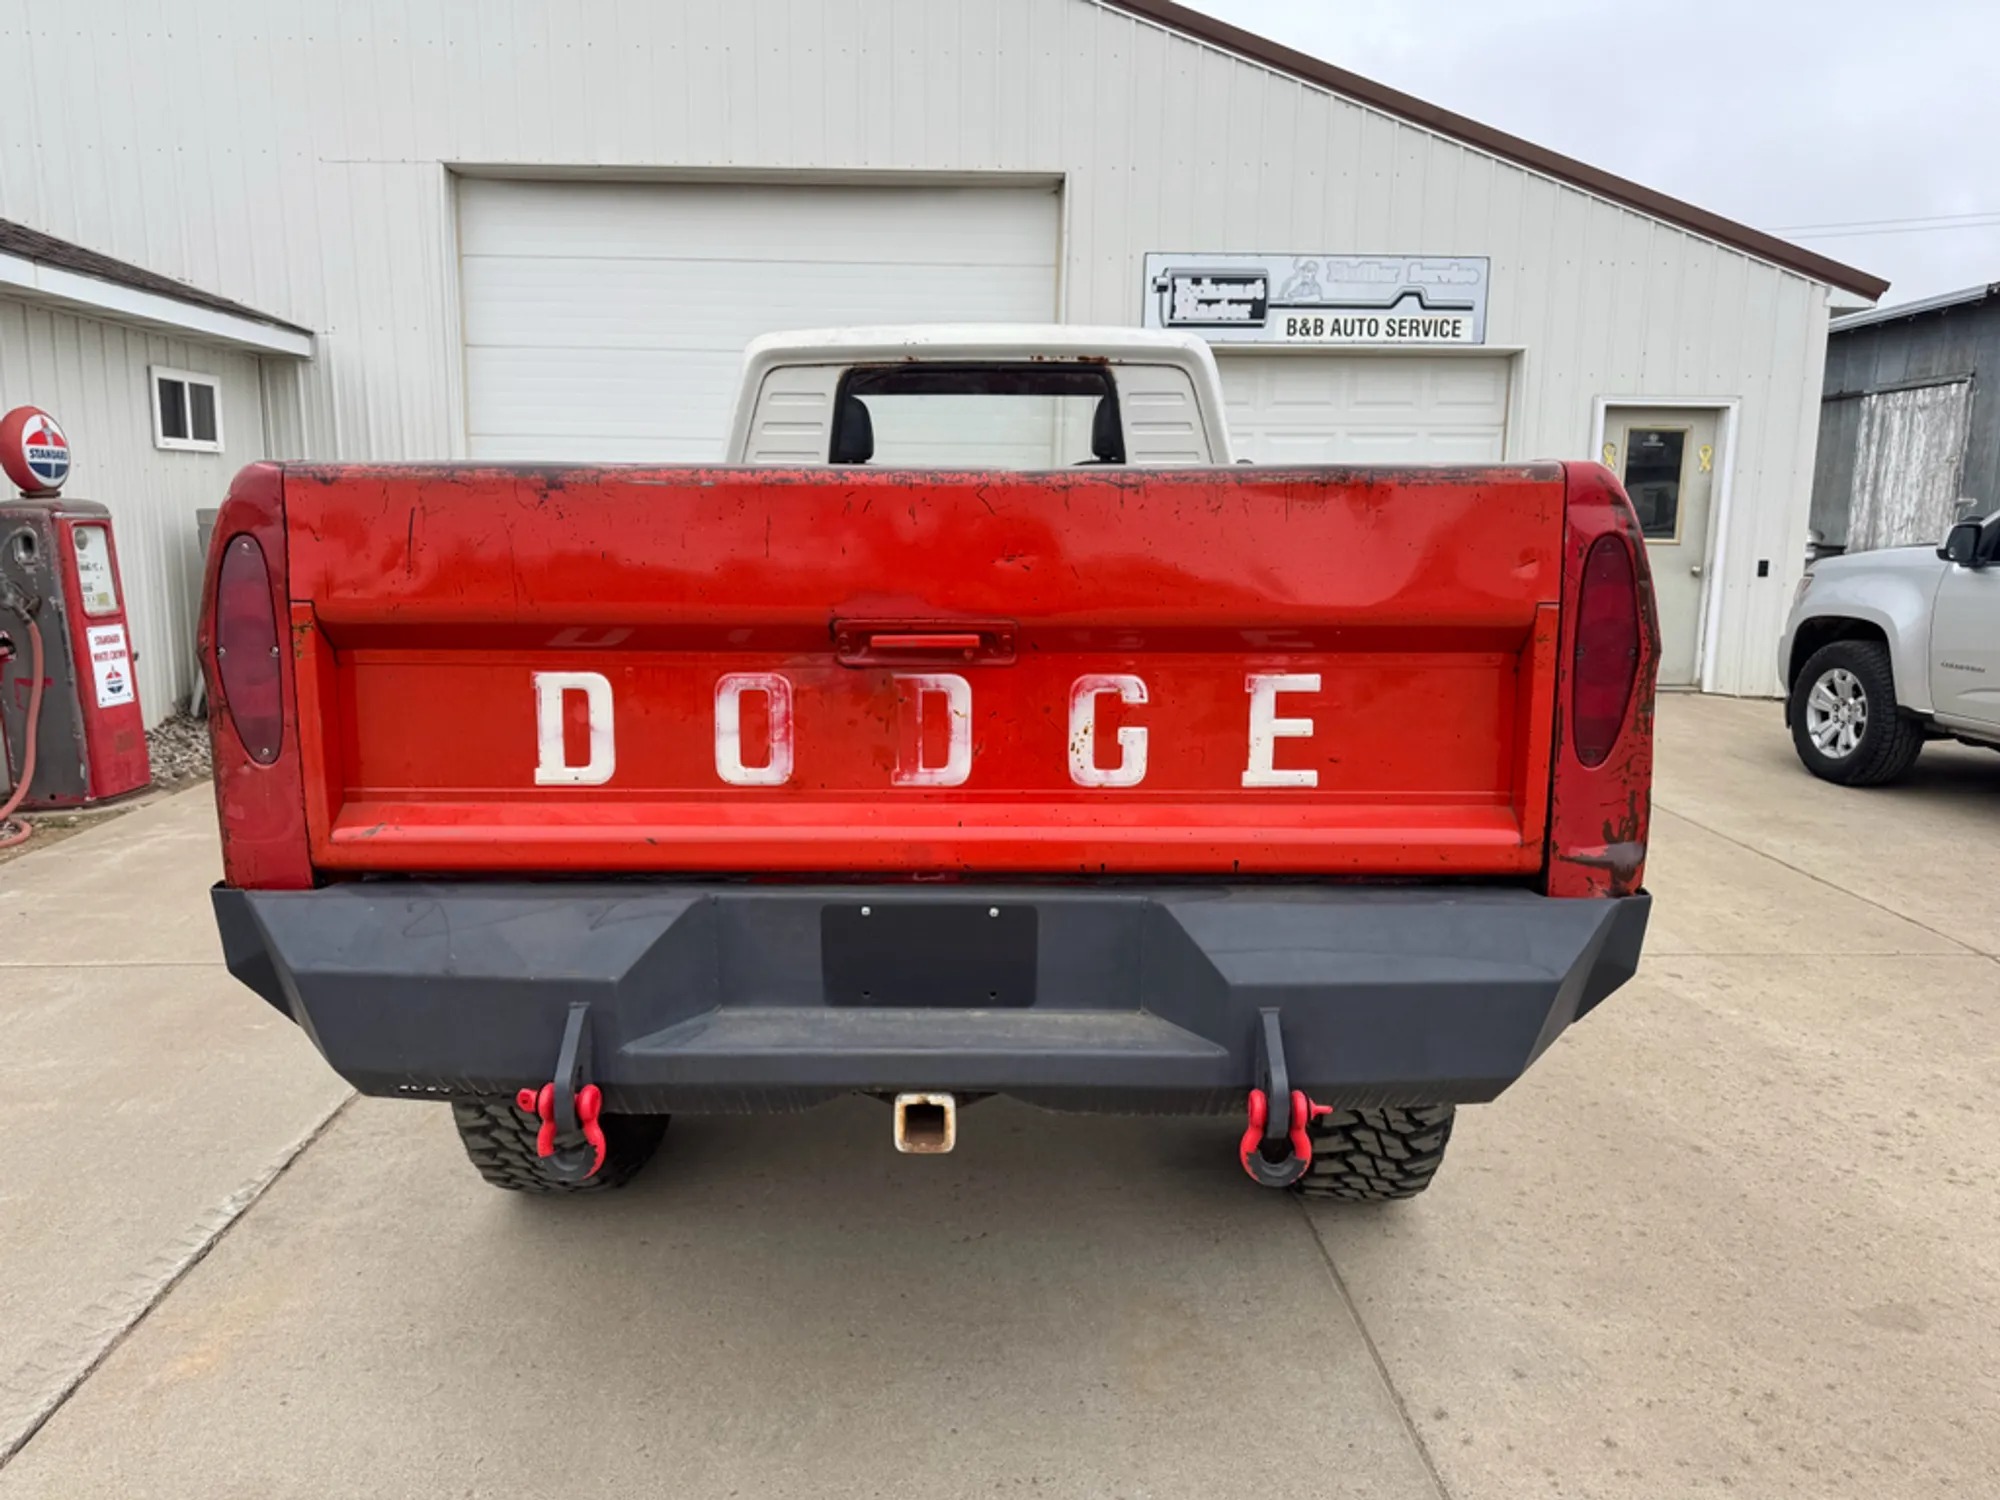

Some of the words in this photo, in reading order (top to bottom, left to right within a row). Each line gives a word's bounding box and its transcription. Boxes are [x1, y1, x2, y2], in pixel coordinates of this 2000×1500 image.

[1287, 318, 1324, 336] B&B
[1330, 318, 1379, 337] AUTO
[1385, 318, 1462, 338] SERVICE
[533, 671, 1321, 788] DODGE
